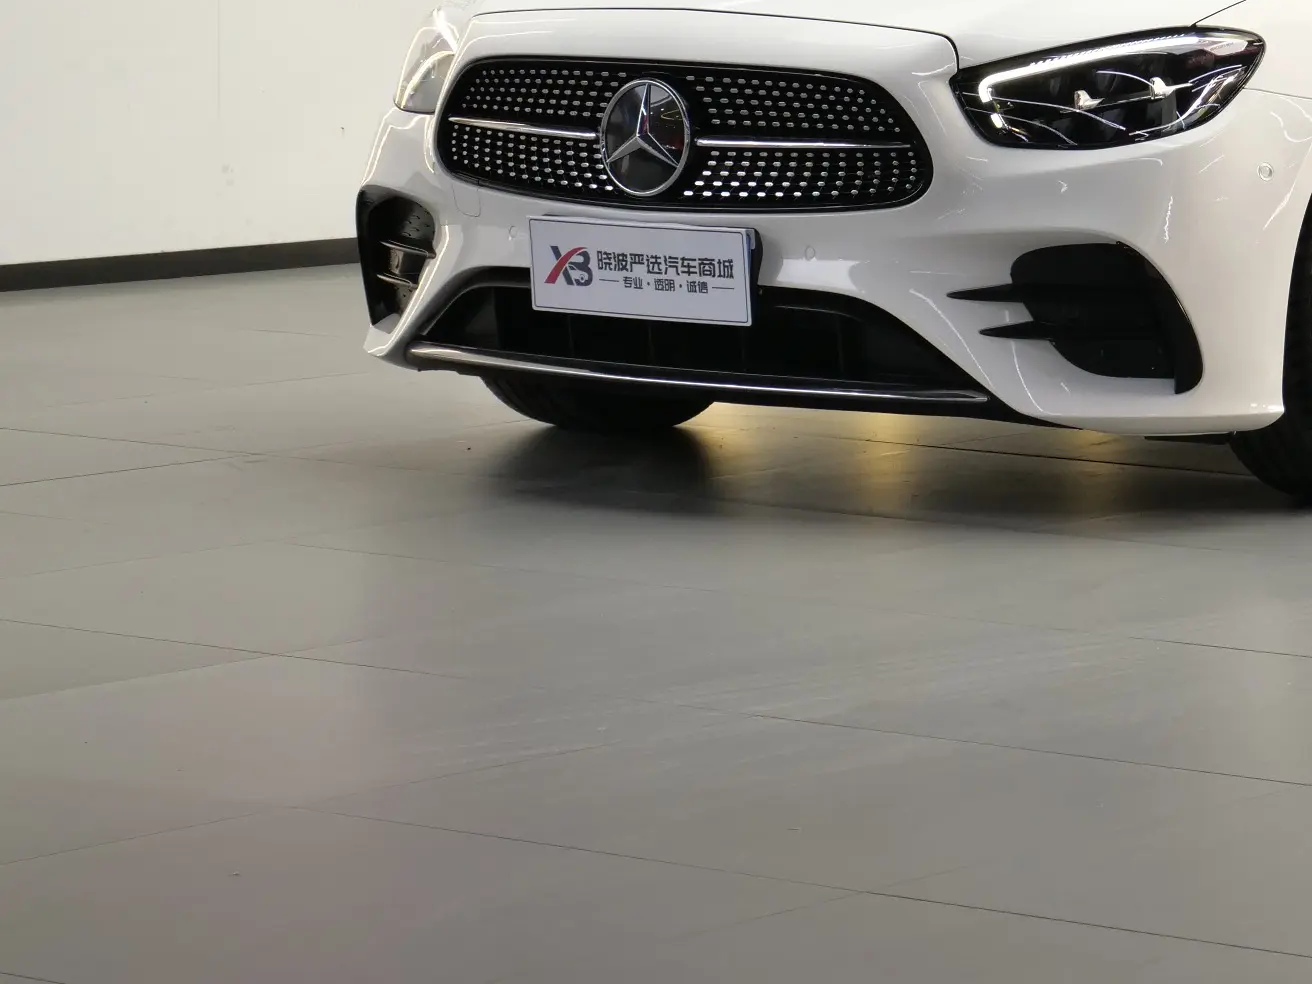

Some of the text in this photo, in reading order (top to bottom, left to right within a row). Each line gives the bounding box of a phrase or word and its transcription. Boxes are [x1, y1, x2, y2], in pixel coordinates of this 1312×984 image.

[596, 250, 735, 279] 晓波严选汽车商城
